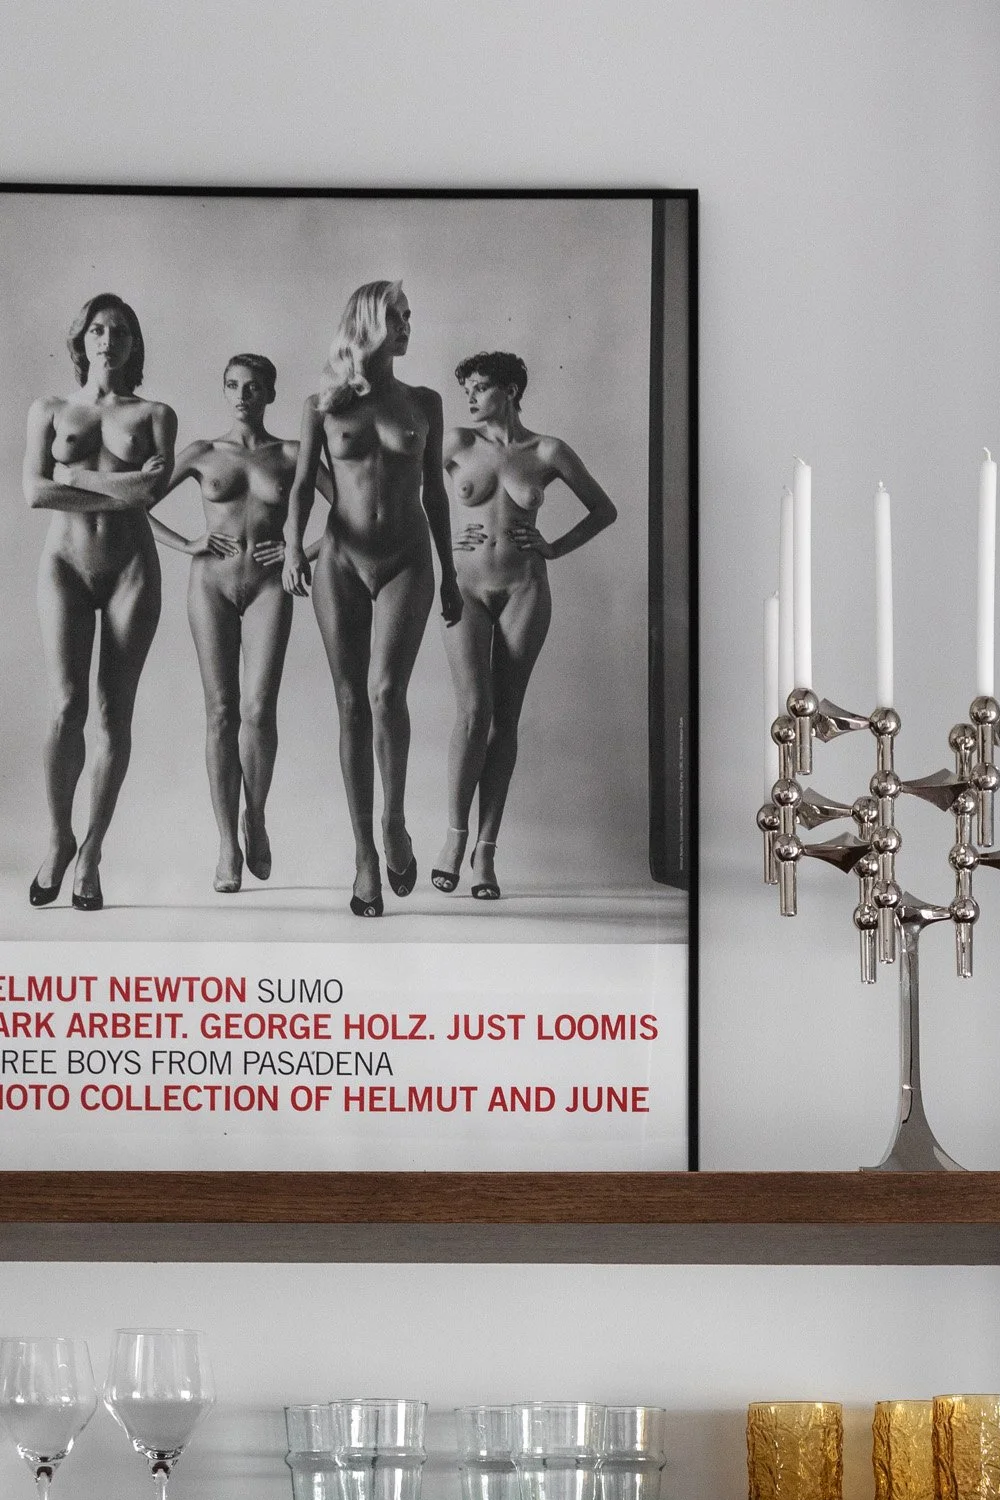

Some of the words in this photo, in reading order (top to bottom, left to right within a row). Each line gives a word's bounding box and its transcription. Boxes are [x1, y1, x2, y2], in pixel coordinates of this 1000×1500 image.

[110, 977, 246, 1003] NEWTON
[258, 978, 343, 1004] SUMO
[67, 1013, 188, 1039] ARBEIT.
[201, 1013, 331, 1040] GEORGE
[345, 1014, 435, 1040] HOLZ.
[447, 1015, 526, 1041] JUST
[538, 1015, 659, 1041] LOOMIS
[1, 1050, 57, 1075] REE
[68, 1050, 142, 1075] BOYS
[153, 1051, 232, 1076] FROM
[244, 1050, 394, 1076] PASADENA
[0, 1084, 70, 1111] OTO
[81, 1085, 279, 1112] COLLECTION
[291, 1086, 332, 1112] OF
[345, 1086, 478, 1112] HELMUT
[488, 1087, 556, 1113] AND
[566, 1087, 650, 1113] JUNE
